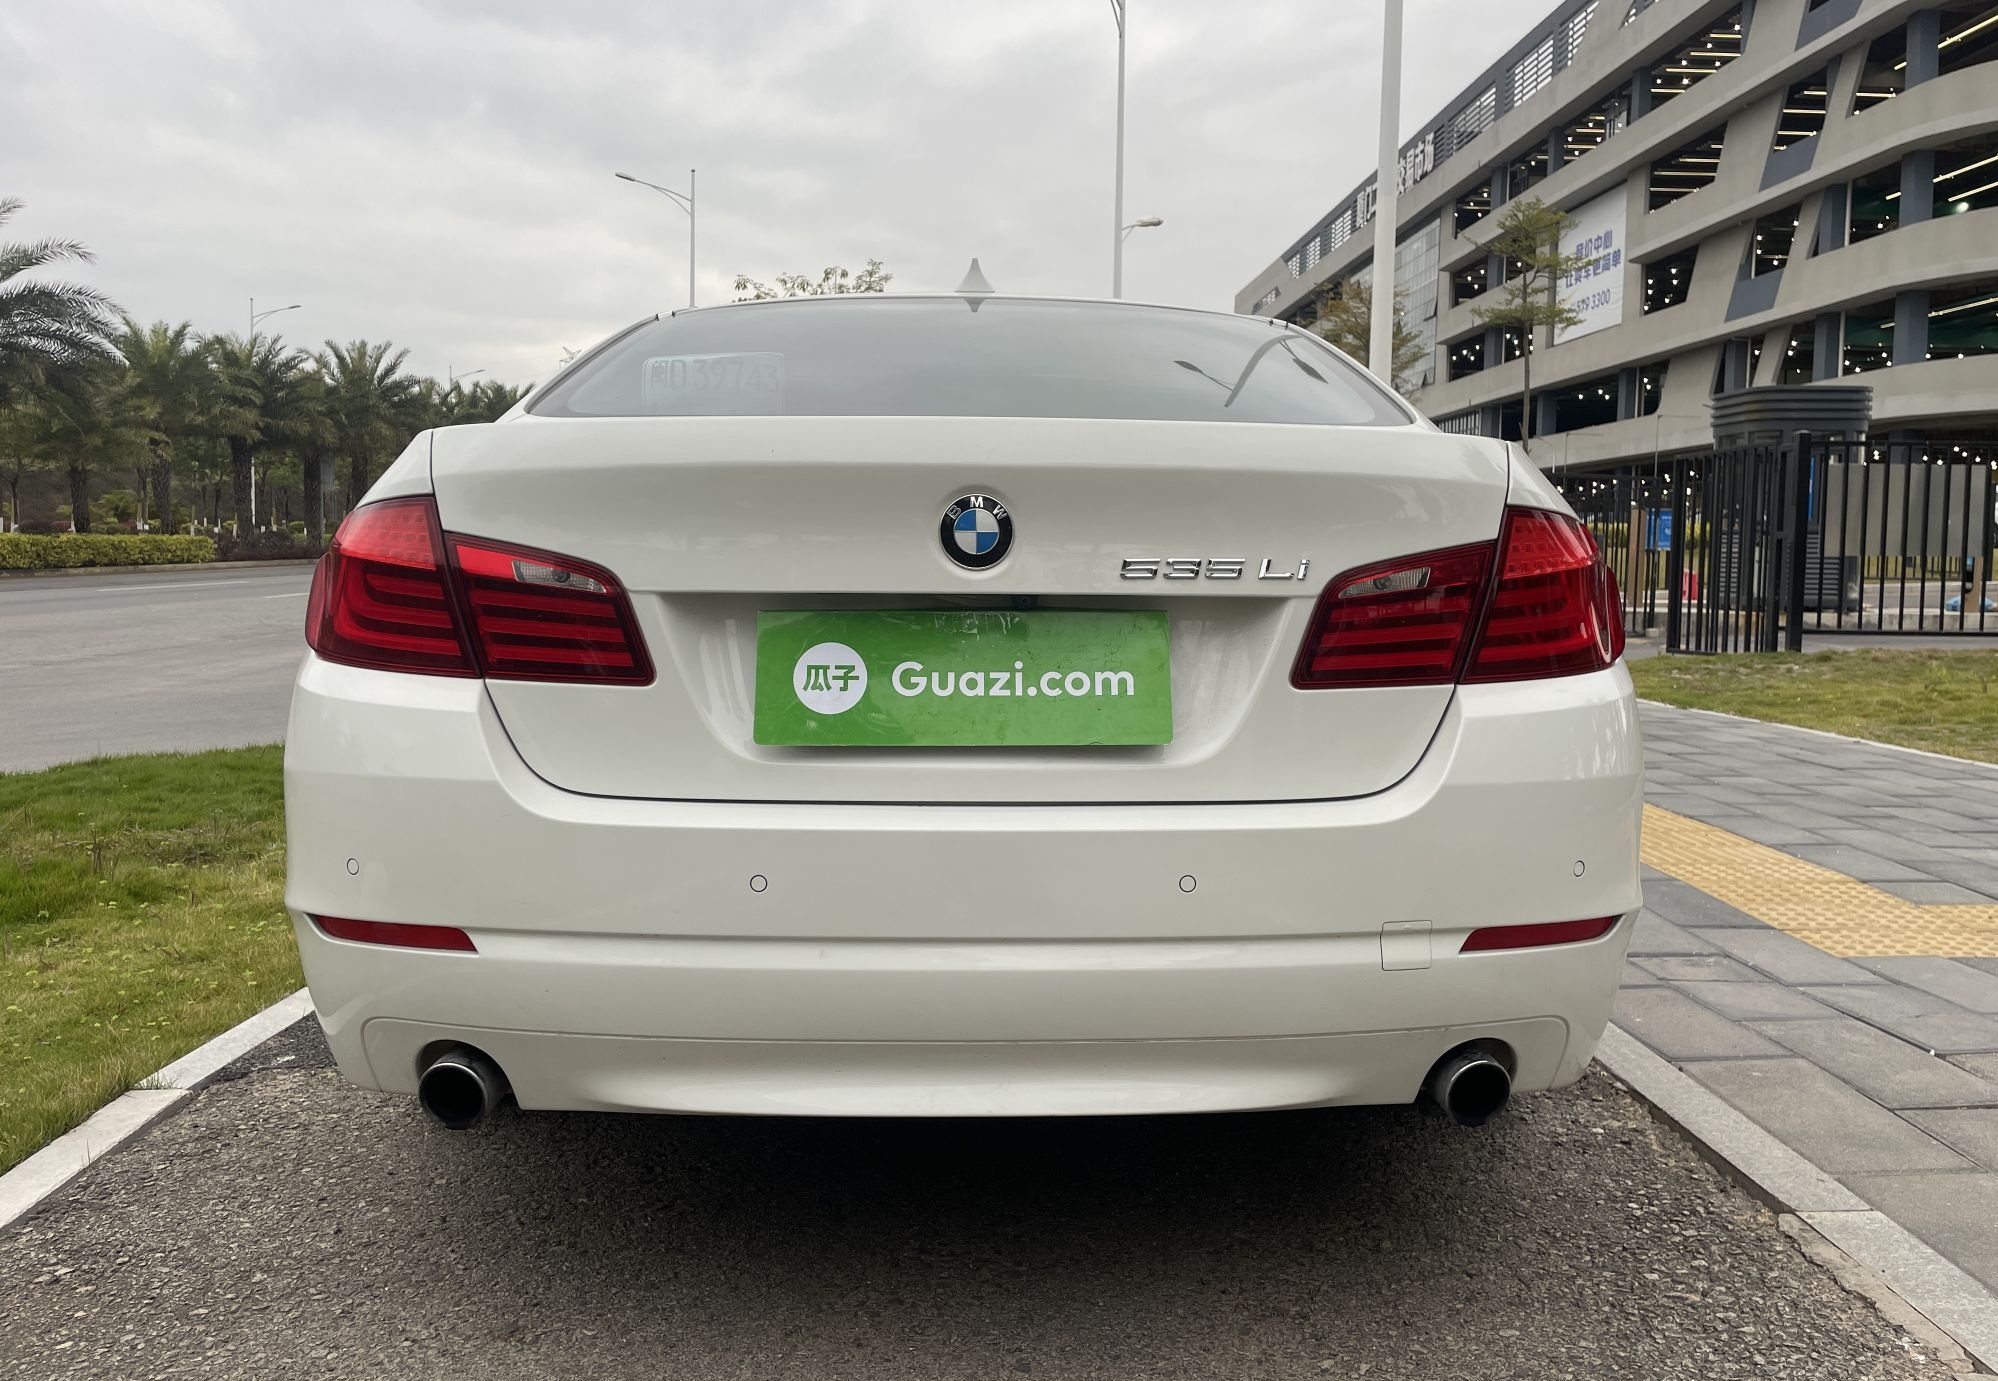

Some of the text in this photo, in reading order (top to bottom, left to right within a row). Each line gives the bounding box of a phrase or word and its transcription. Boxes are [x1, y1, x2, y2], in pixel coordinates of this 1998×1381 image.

[1591, 288, 1611, 310] 3300
[946, 496, 1008, 520] BMW
[1119, 558, 1310, 579] 535 Li
[802, 664, 860, 692] 瓜子
[891, 660, 1135, 697] Guazi.com
